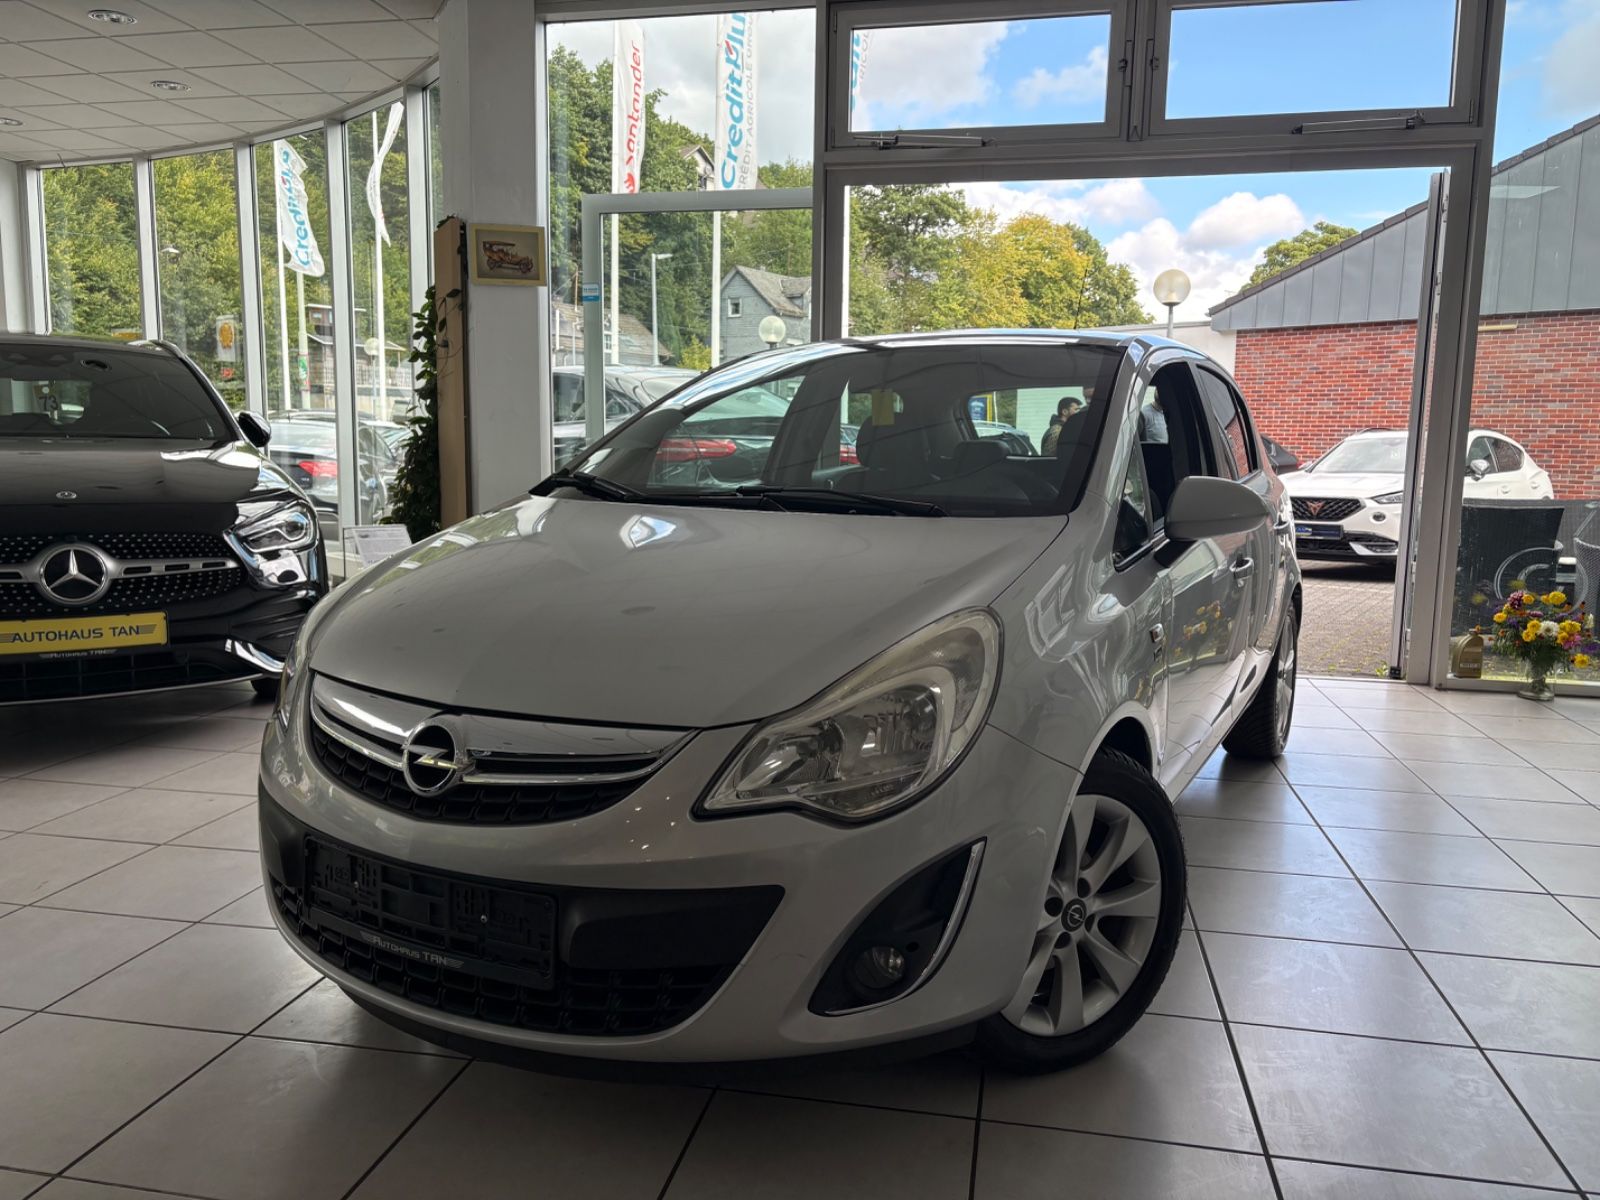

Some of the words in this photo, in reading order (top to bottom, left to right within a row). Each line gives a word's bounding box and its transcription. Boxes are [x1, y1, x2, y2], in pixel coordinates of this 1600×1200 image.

[745, 63, 753, 137] AGRICOLE
[11, 628, 103, 643] AUTOHAUS
[109, 625, 140, 636] TAN
[422, 951, 447, 965] TAN
